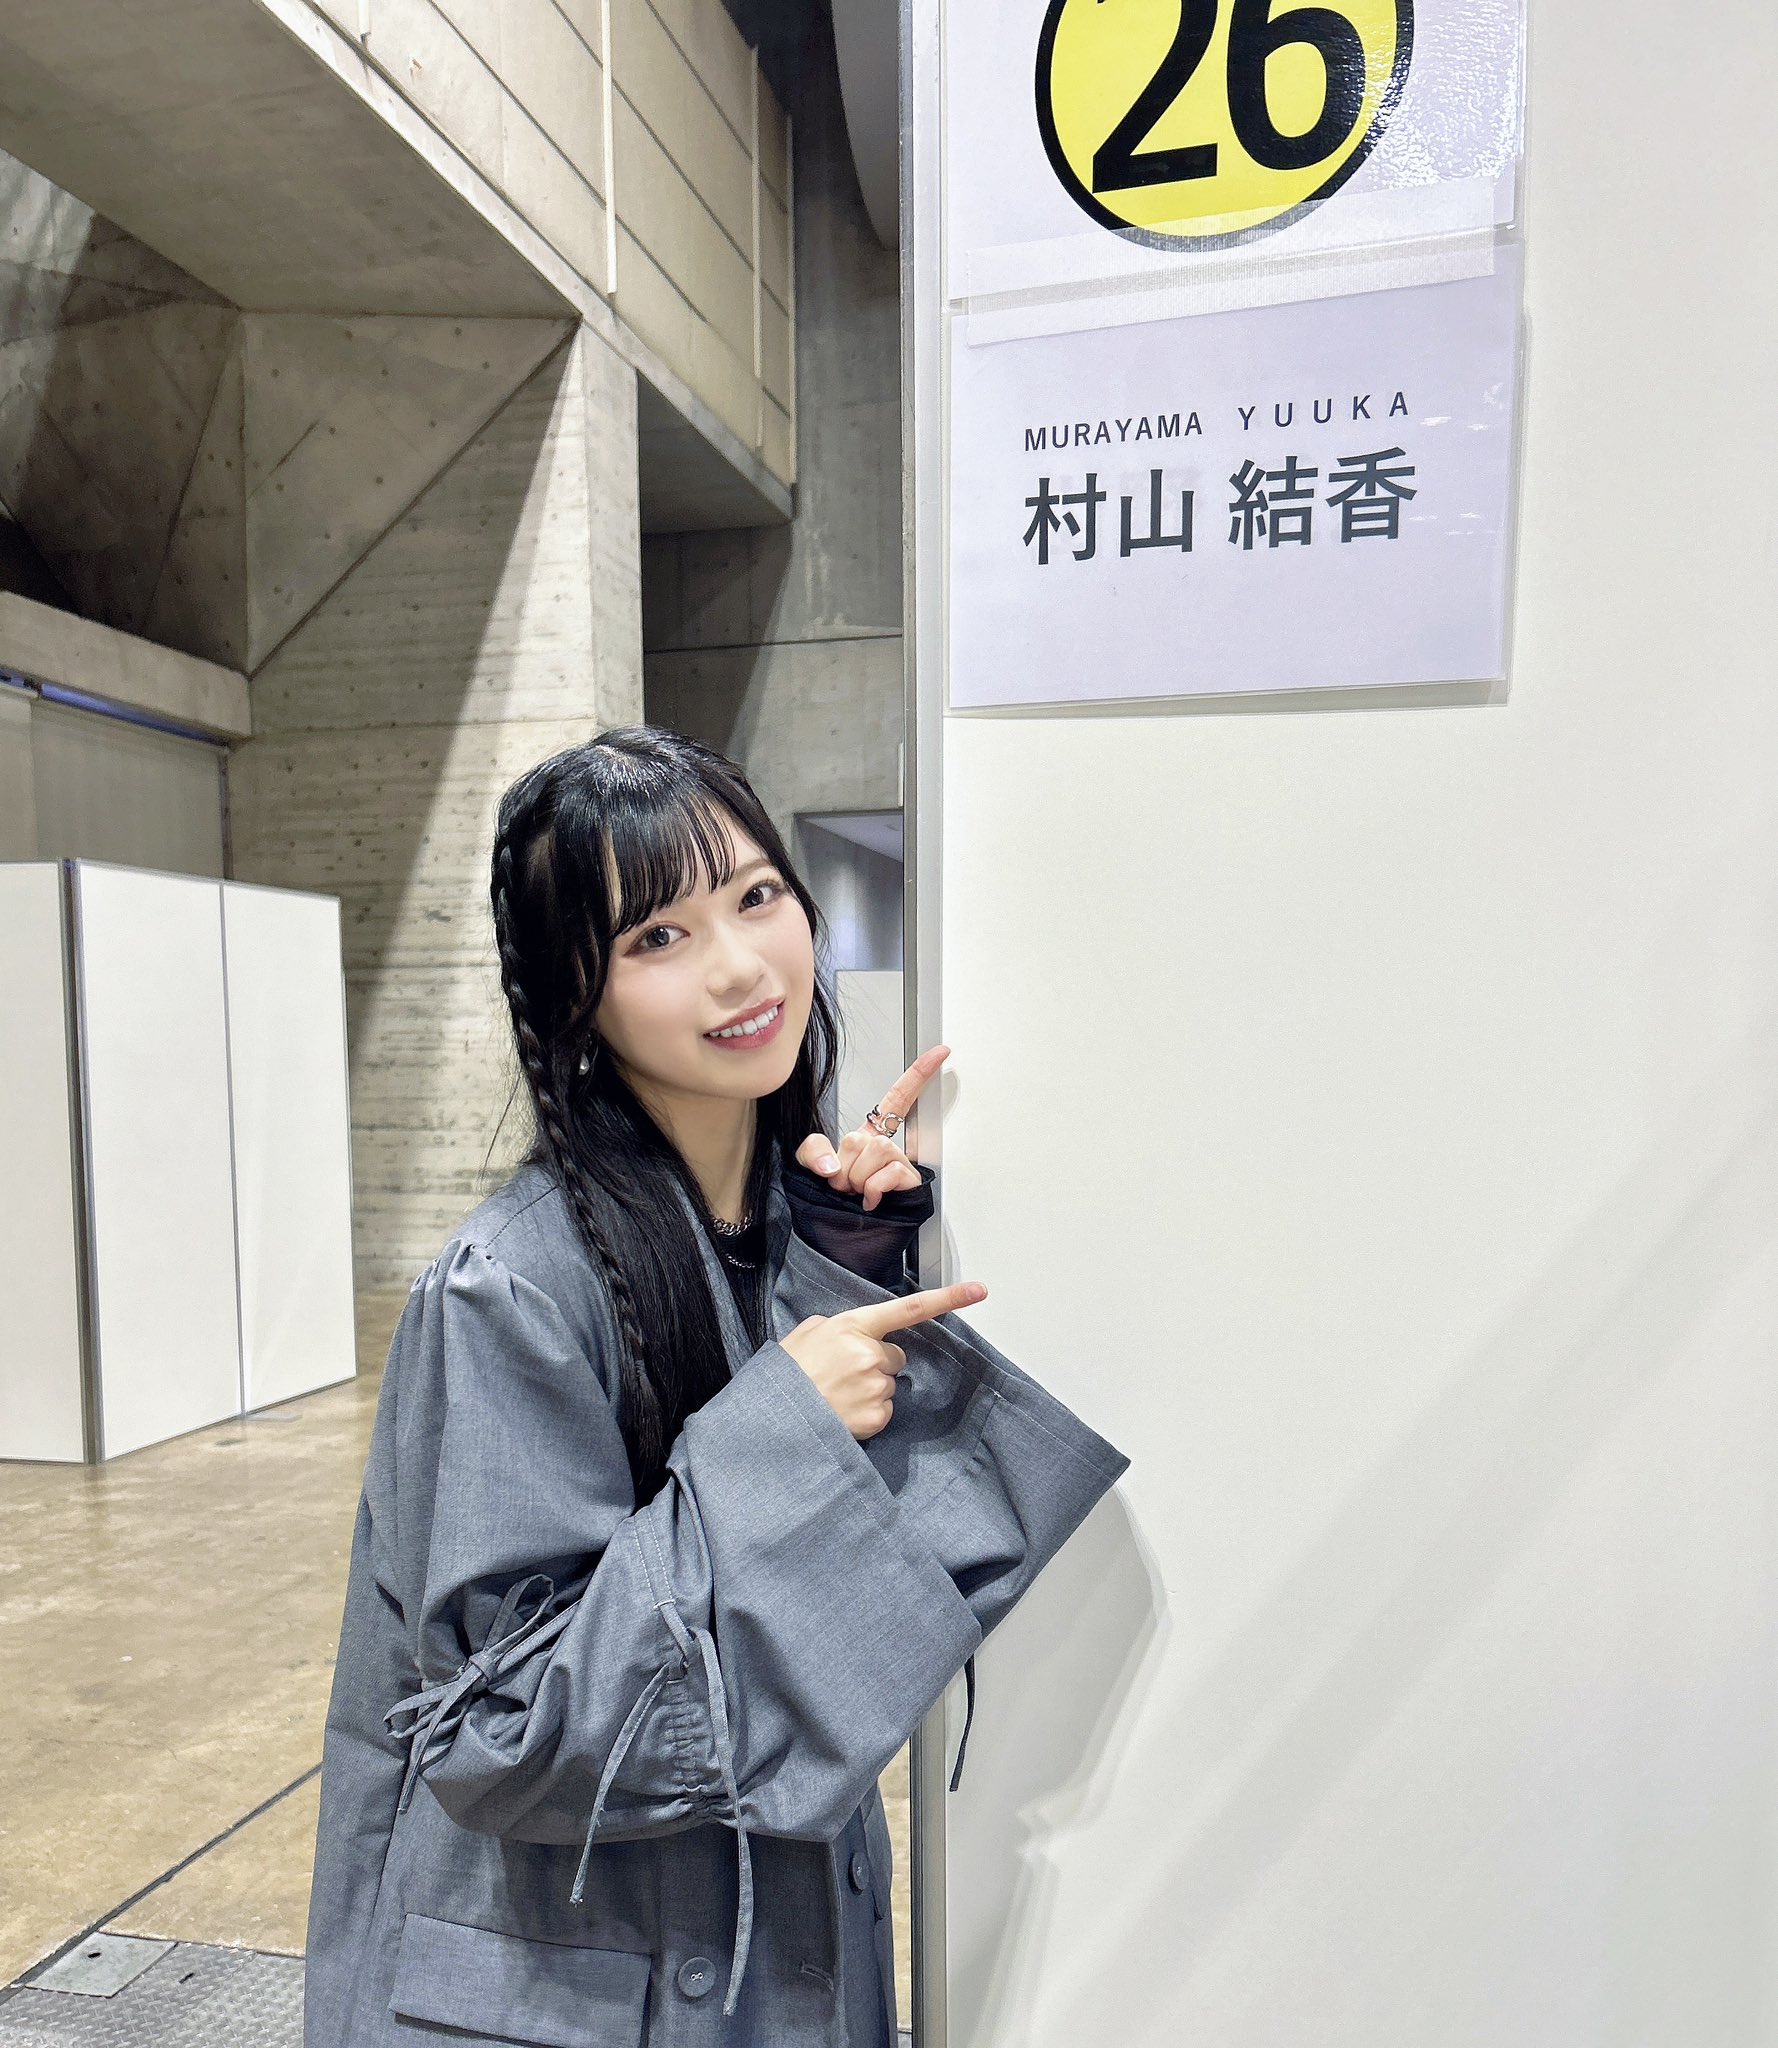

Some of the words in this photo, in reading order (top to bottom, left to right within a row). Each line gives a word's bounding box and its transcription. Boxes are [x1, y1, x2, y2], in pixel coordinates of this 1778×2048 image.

[1093, 0, 1366, 193] 26
[1025, 411, 1203, 452] MURAYAMA
[1237, 391, 1409, 431] YUUKA
[1022, 468, 1195, 566] 村山
[1227, 447, 1417, 551] 結香
